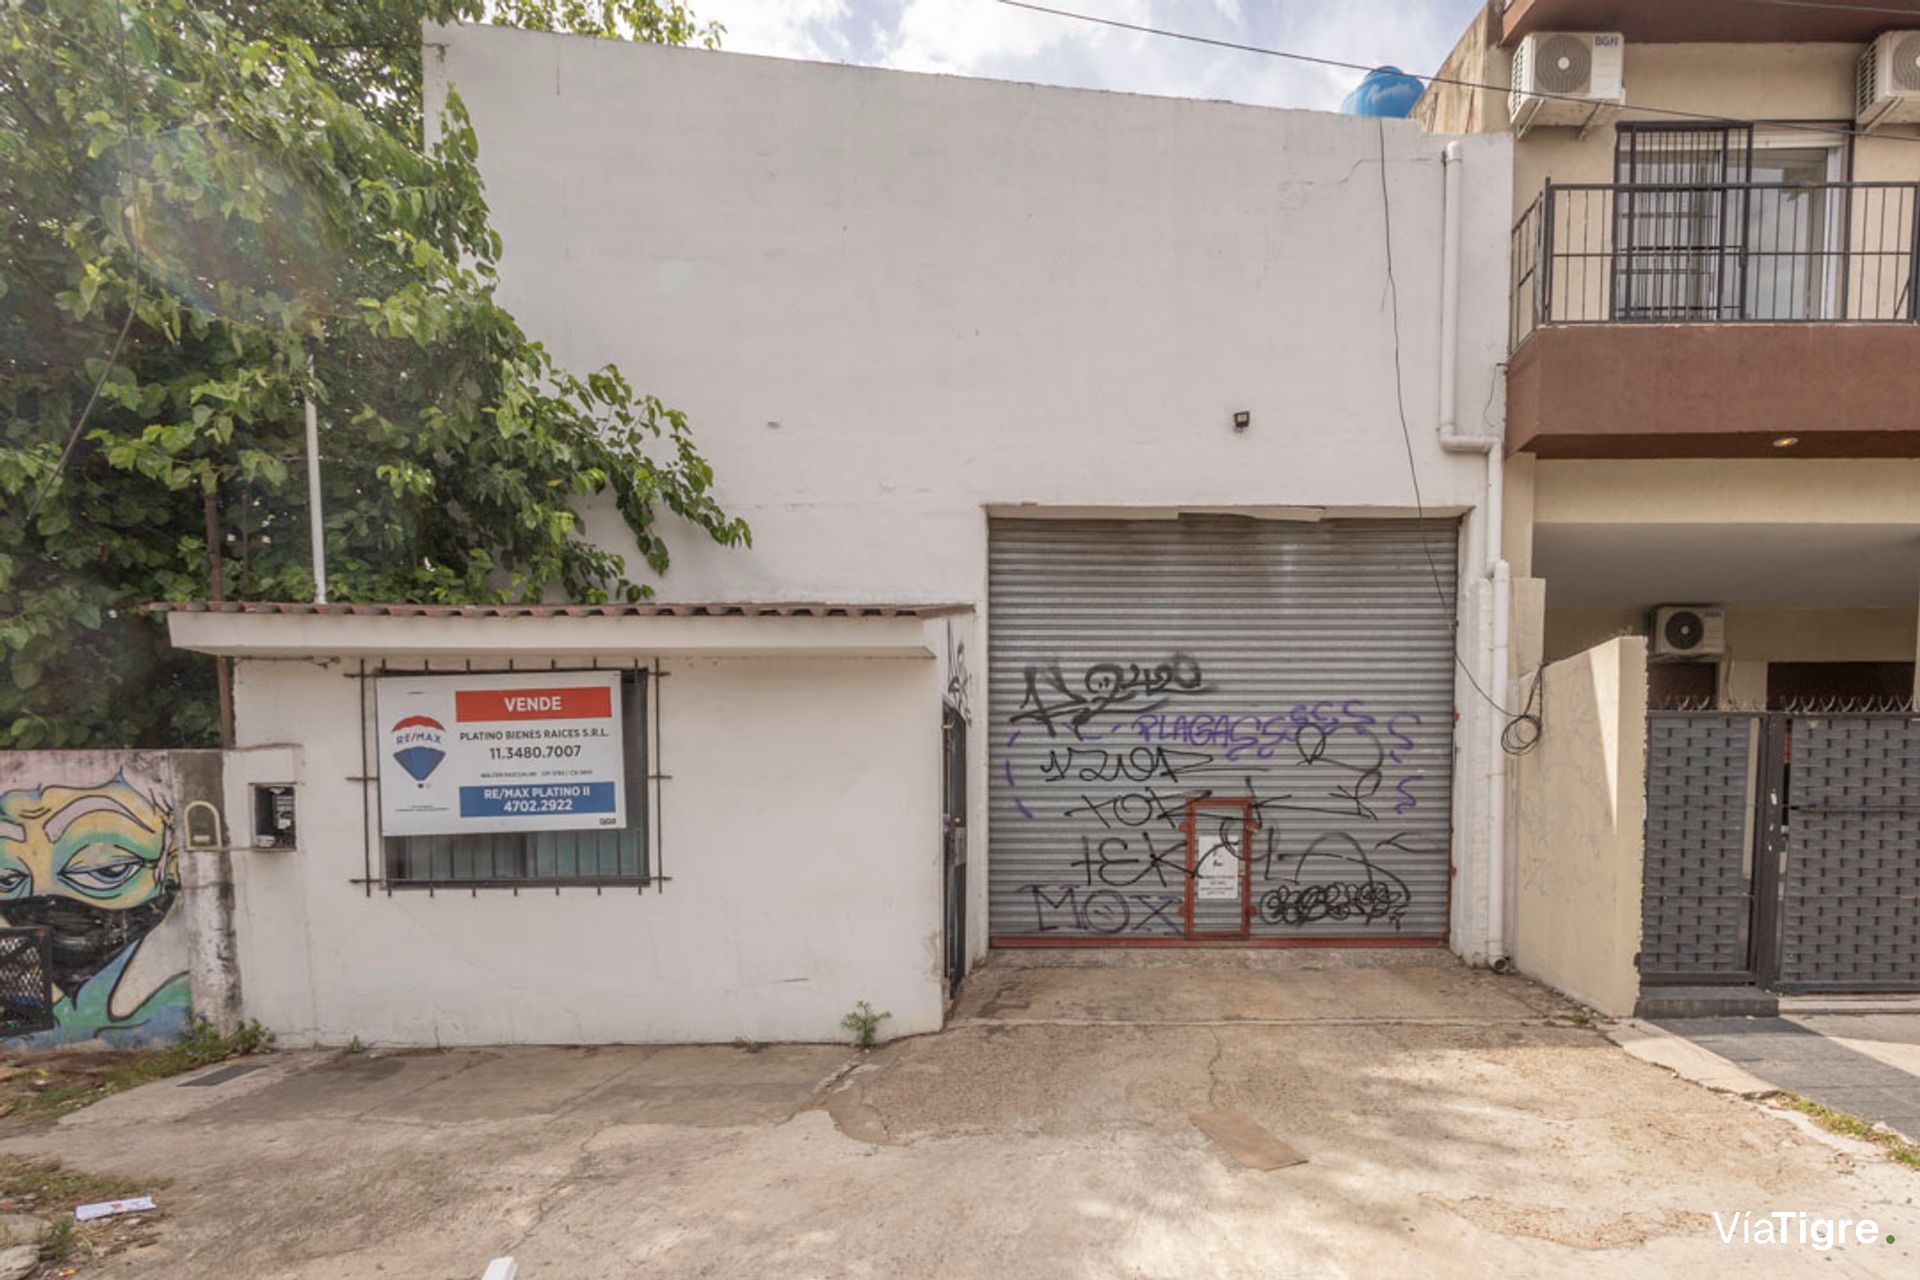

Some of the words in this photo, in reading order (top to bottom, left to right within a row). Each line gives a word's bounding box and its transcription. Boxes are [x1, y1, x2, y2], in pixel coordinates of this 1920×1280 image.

[504, 696, 562, 712] VENDE
[396, 732, 442, 745] RE/MAX
[459, 730, 504, 742] PLATINO
[505, 729, 542, 740] BIENES
[543, 728, 580, 739] RAICES
[490, 745, 582, 760] 11.3480.7007
[483, 787, 530, 800] RE/MAX
[531, 786, 581, 798] PLATINO
[582, 786, 590, 796] II
[503, 799, 573, 812] 4702.2922
